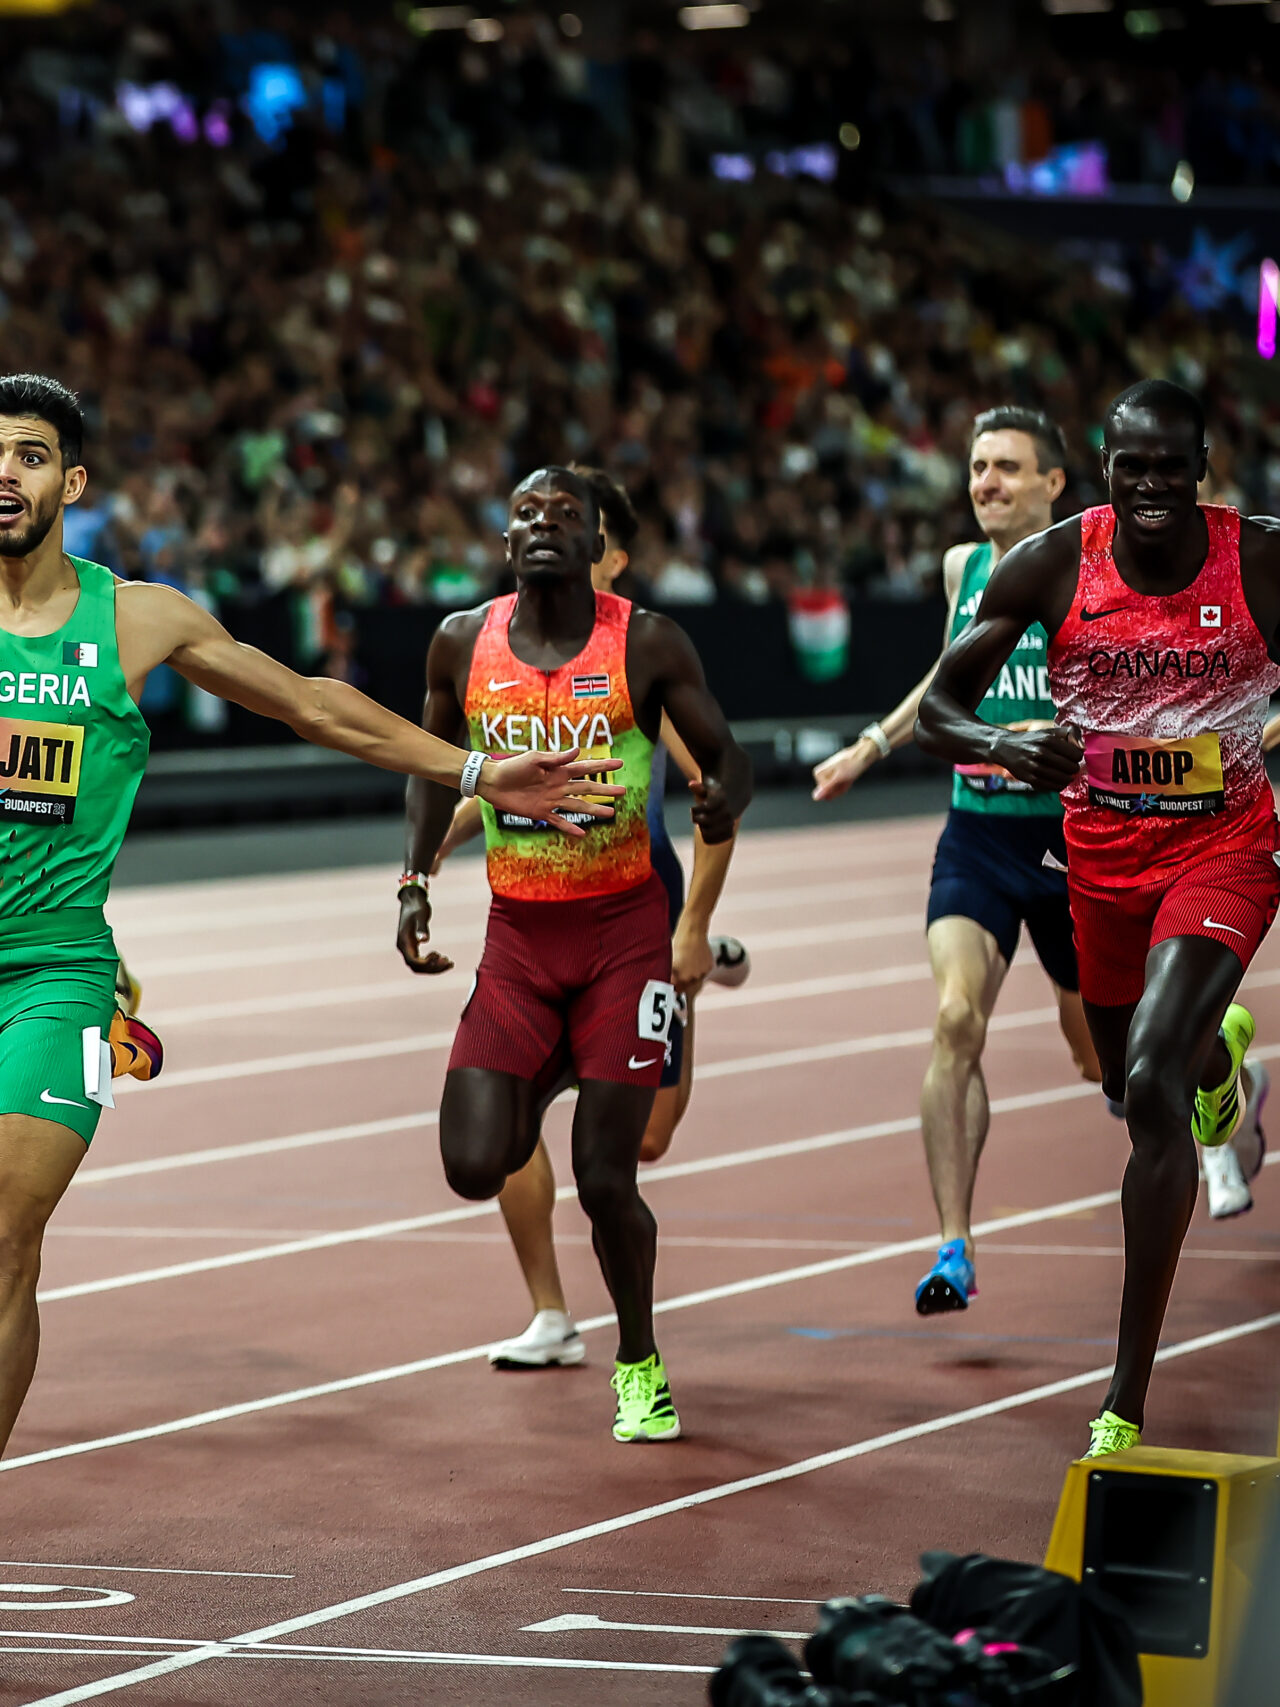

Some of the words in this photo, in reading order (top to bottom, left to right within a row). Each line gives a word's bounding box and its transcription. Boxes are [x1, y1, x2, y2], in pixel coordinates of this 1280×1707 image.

[1088, 650, 1230, 678] CANADA
[481, 712, 614, 752] KENYA
[1111, 748, 1194, 786] AROP
[4, 798, 53, 814] BUDAPEST
[1095, 793, 1131, 810] ULTIMATE
[1160, 800, 1203, 811] BUDAPEST
[651, 991, 667, 1033] 5
